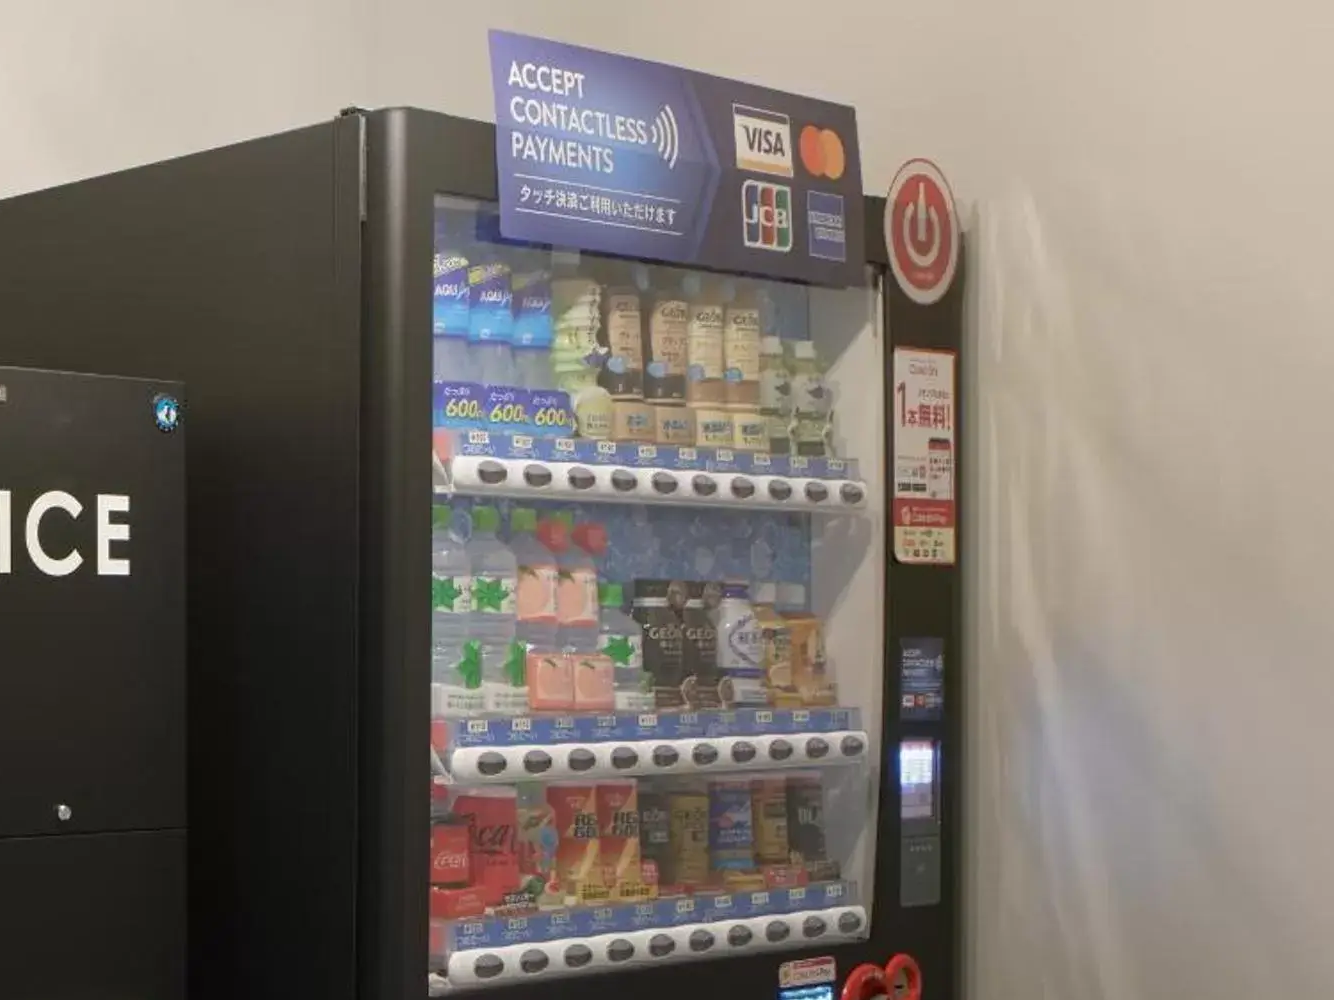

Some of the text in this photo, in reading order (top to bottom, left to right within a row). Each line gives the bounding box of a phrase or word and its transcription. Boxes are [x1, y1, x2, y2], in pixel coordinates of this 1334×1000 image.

[508, 60, 585, 98] ACCEPT
[510, 96, 647, 146] CONTACTLESS
[742, 124, 785, 157] VISA
[511, 131, 614, 173] PAYMENTS
[519, 185, 676, 226] タッチ決済ご利用いただけます
[745, 202, 789, 229] JCB
